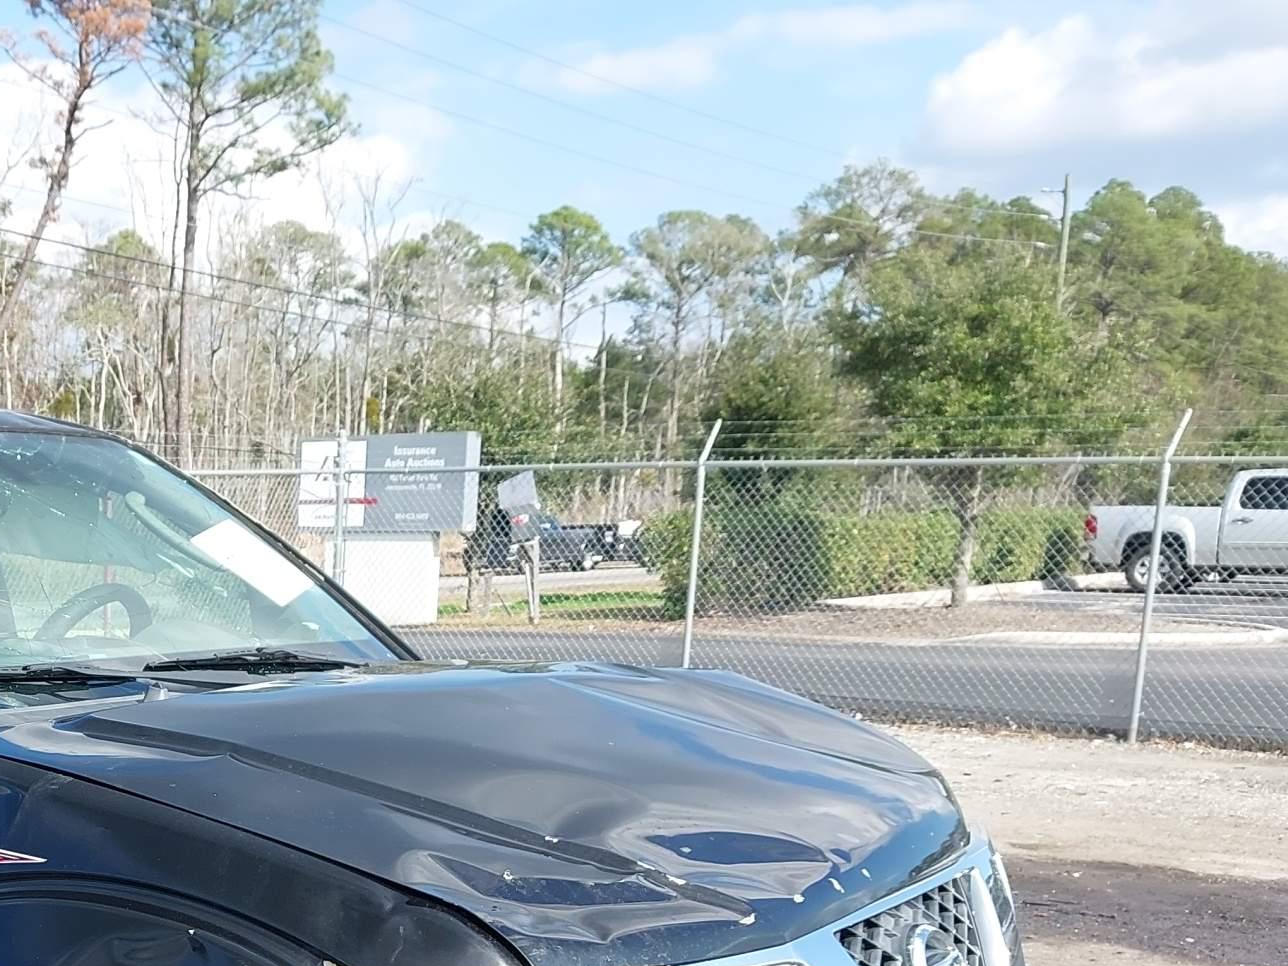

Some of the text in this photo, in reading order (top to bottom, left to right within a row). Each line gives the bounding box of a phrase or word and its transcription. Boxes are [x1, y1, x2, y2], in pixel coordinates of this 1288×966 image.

[393, 446, 437, 456] Insurance
[384, 457, 445, 467] Auto Auctions
